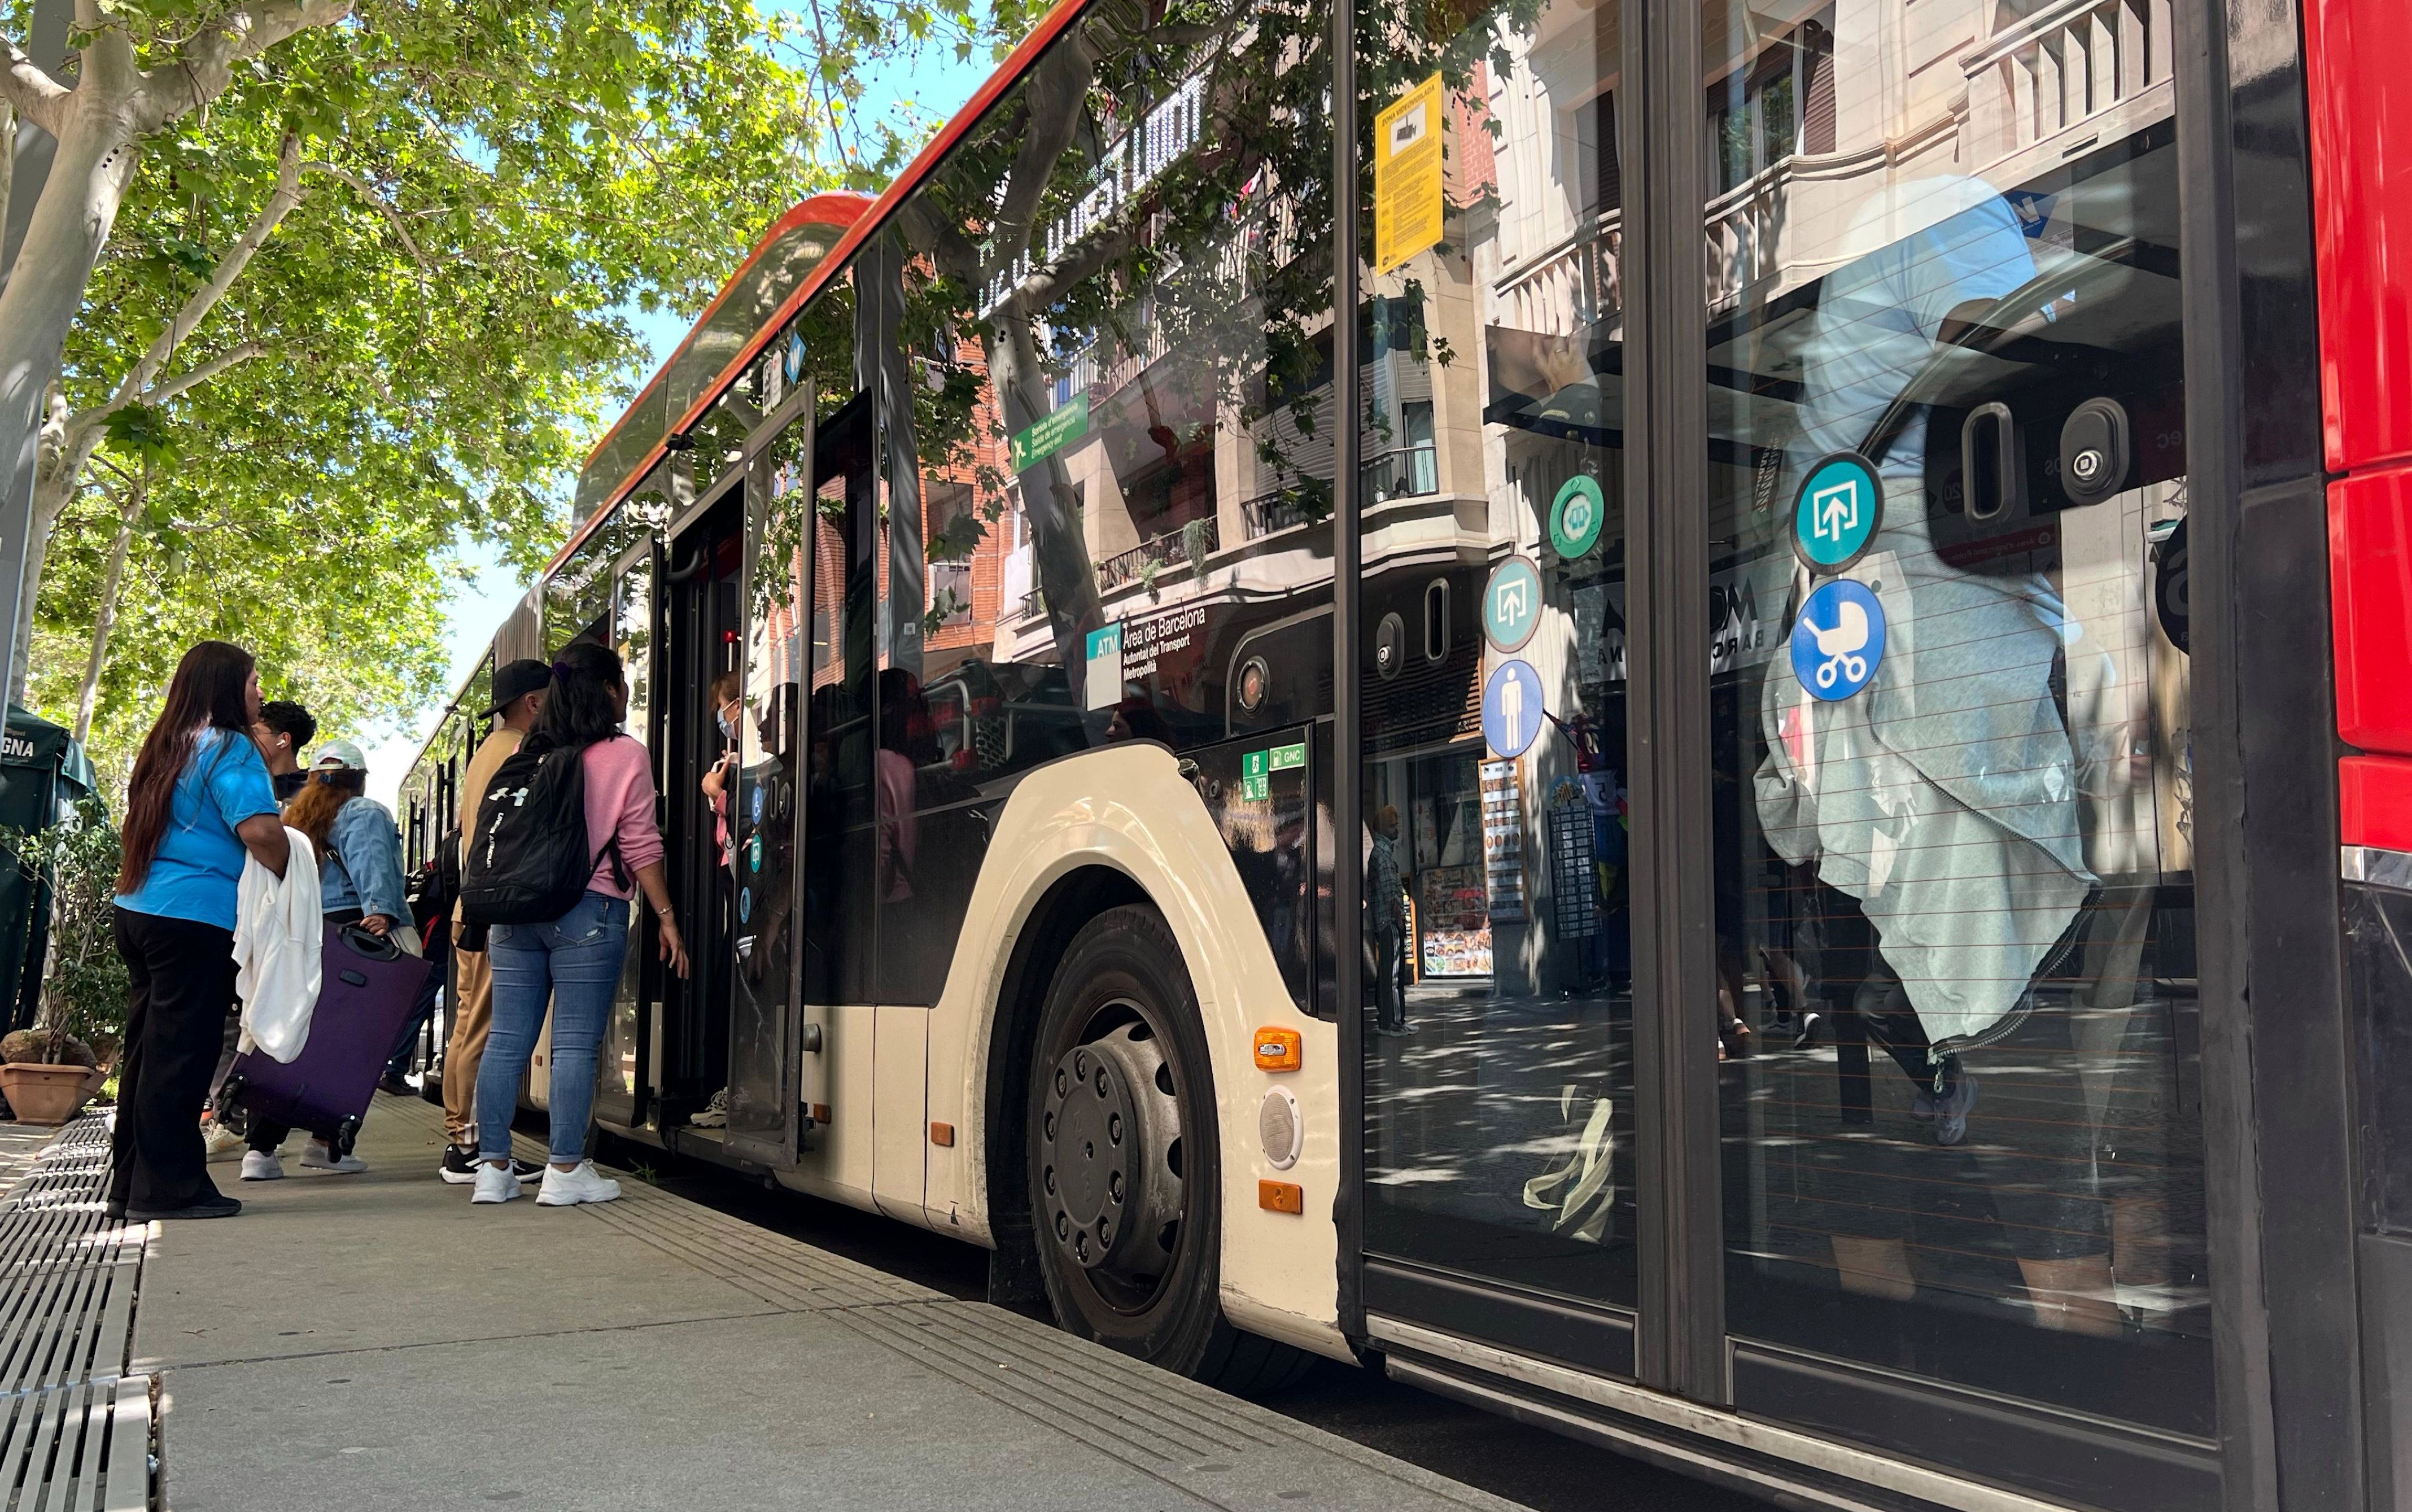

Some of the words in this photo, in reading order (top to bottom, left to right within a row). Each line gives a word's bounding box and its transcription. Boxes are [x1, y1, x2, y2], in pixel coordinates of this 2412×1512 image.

[1144, 622, 1157, 643] de
[1159, 608, 1205, 637] Barcelona
[1097, 634, 1118, 658] ATM
[1149, 639, 1159, 658] del
[1160, 632, 1190, 654] Transport
[1123, 659, 1157, 681] Metropolità
[1284, 749, 1300, 763] GNC
